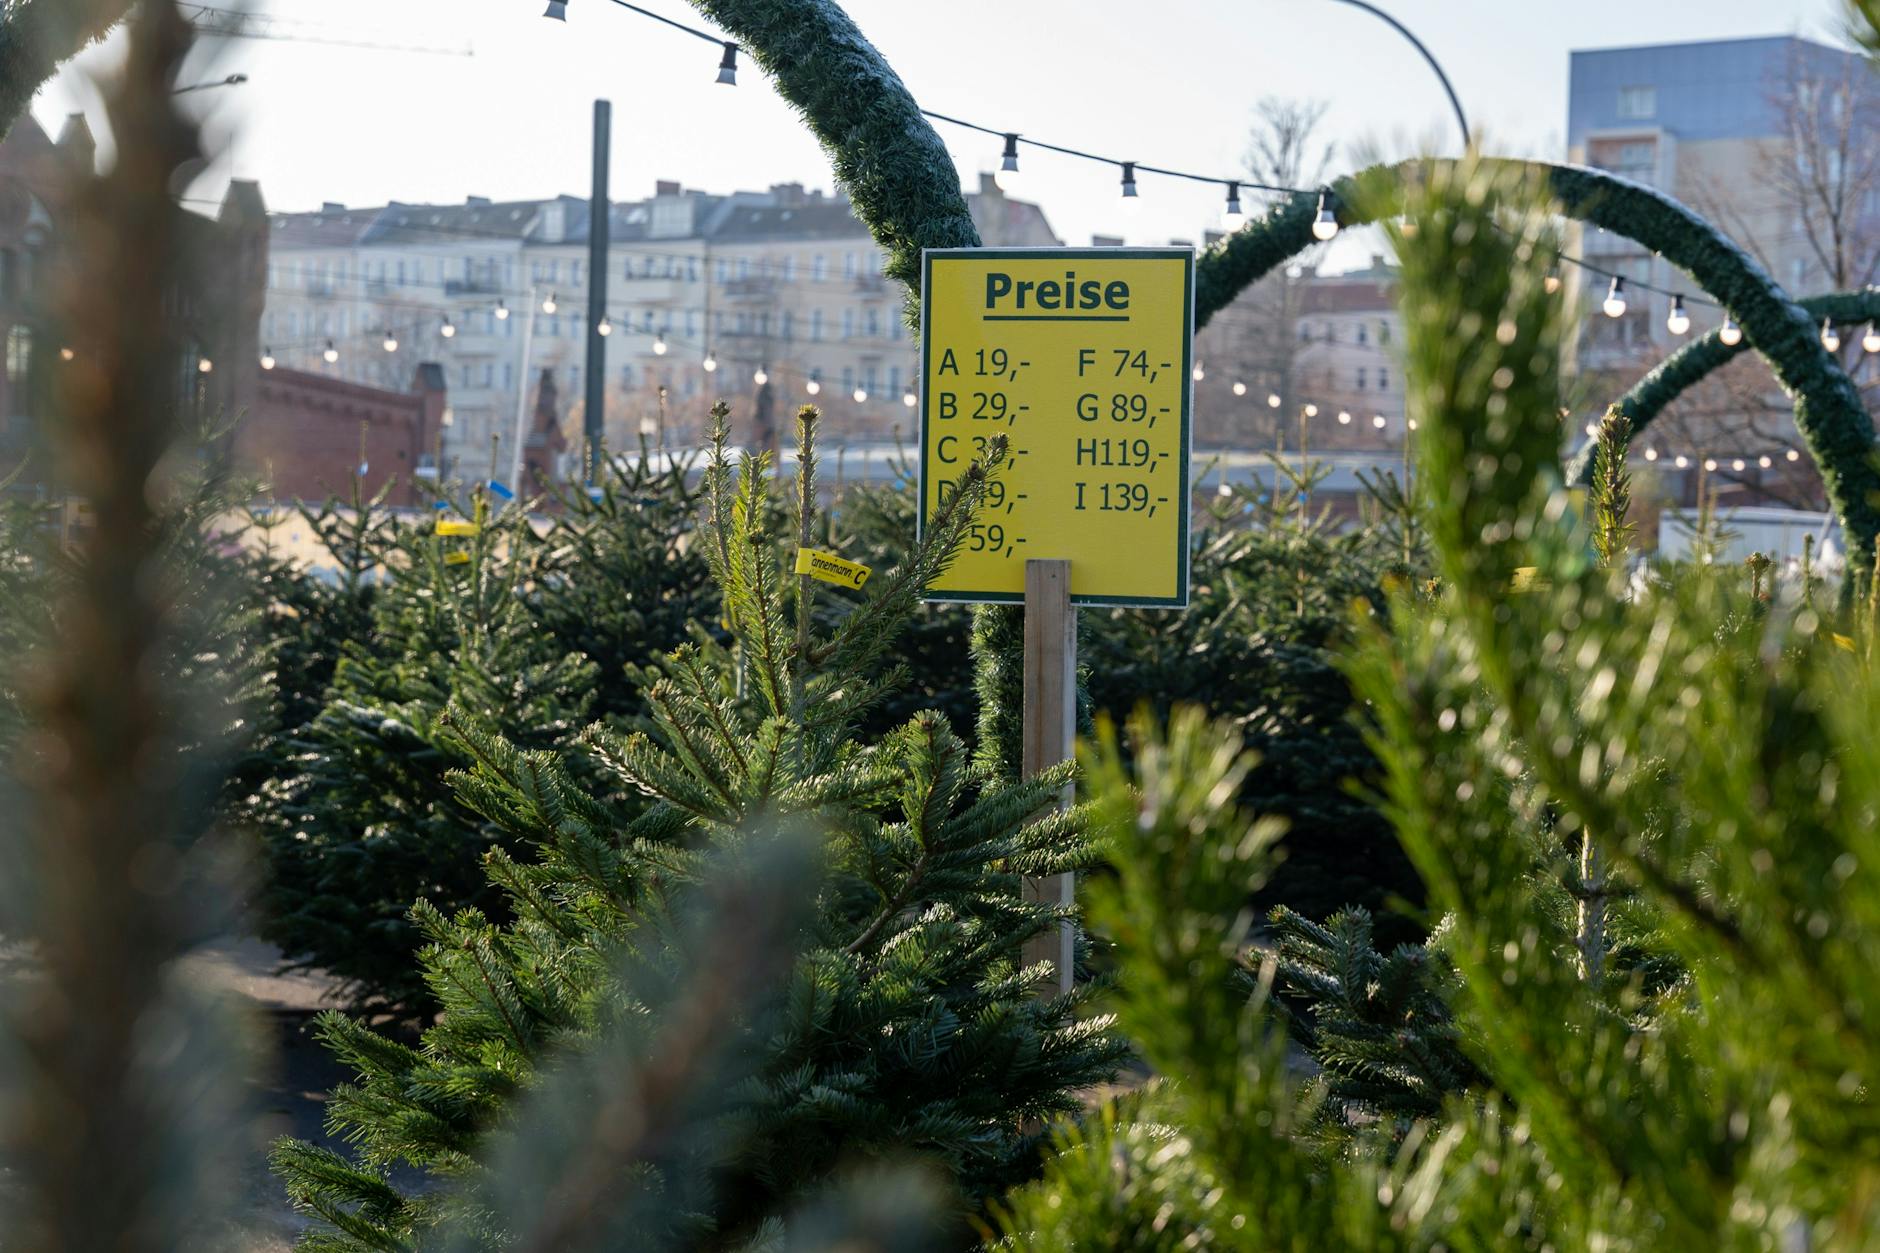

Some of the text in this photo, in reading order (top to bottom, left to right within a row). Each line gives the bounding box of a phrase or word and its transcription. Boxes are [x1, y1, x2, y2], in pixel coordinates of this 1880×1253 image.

[986, 271, 1129, 310] Preise
[939, 349, 1030, 382] A 19,-
[1079, 349, 1171, 384] F 74,-
[940, 392, 1030, 426] B 29,-
[1077, 393, 1170, 428] G 89,-
[938, 436, 1028, 470] C 3,-
[1075, 483, 1168, 518] I 139,-
[969, 523, 1026, 558] 59,-
[811, 553, 853, 577] annenmann
[854, 570, 866, 585] C
